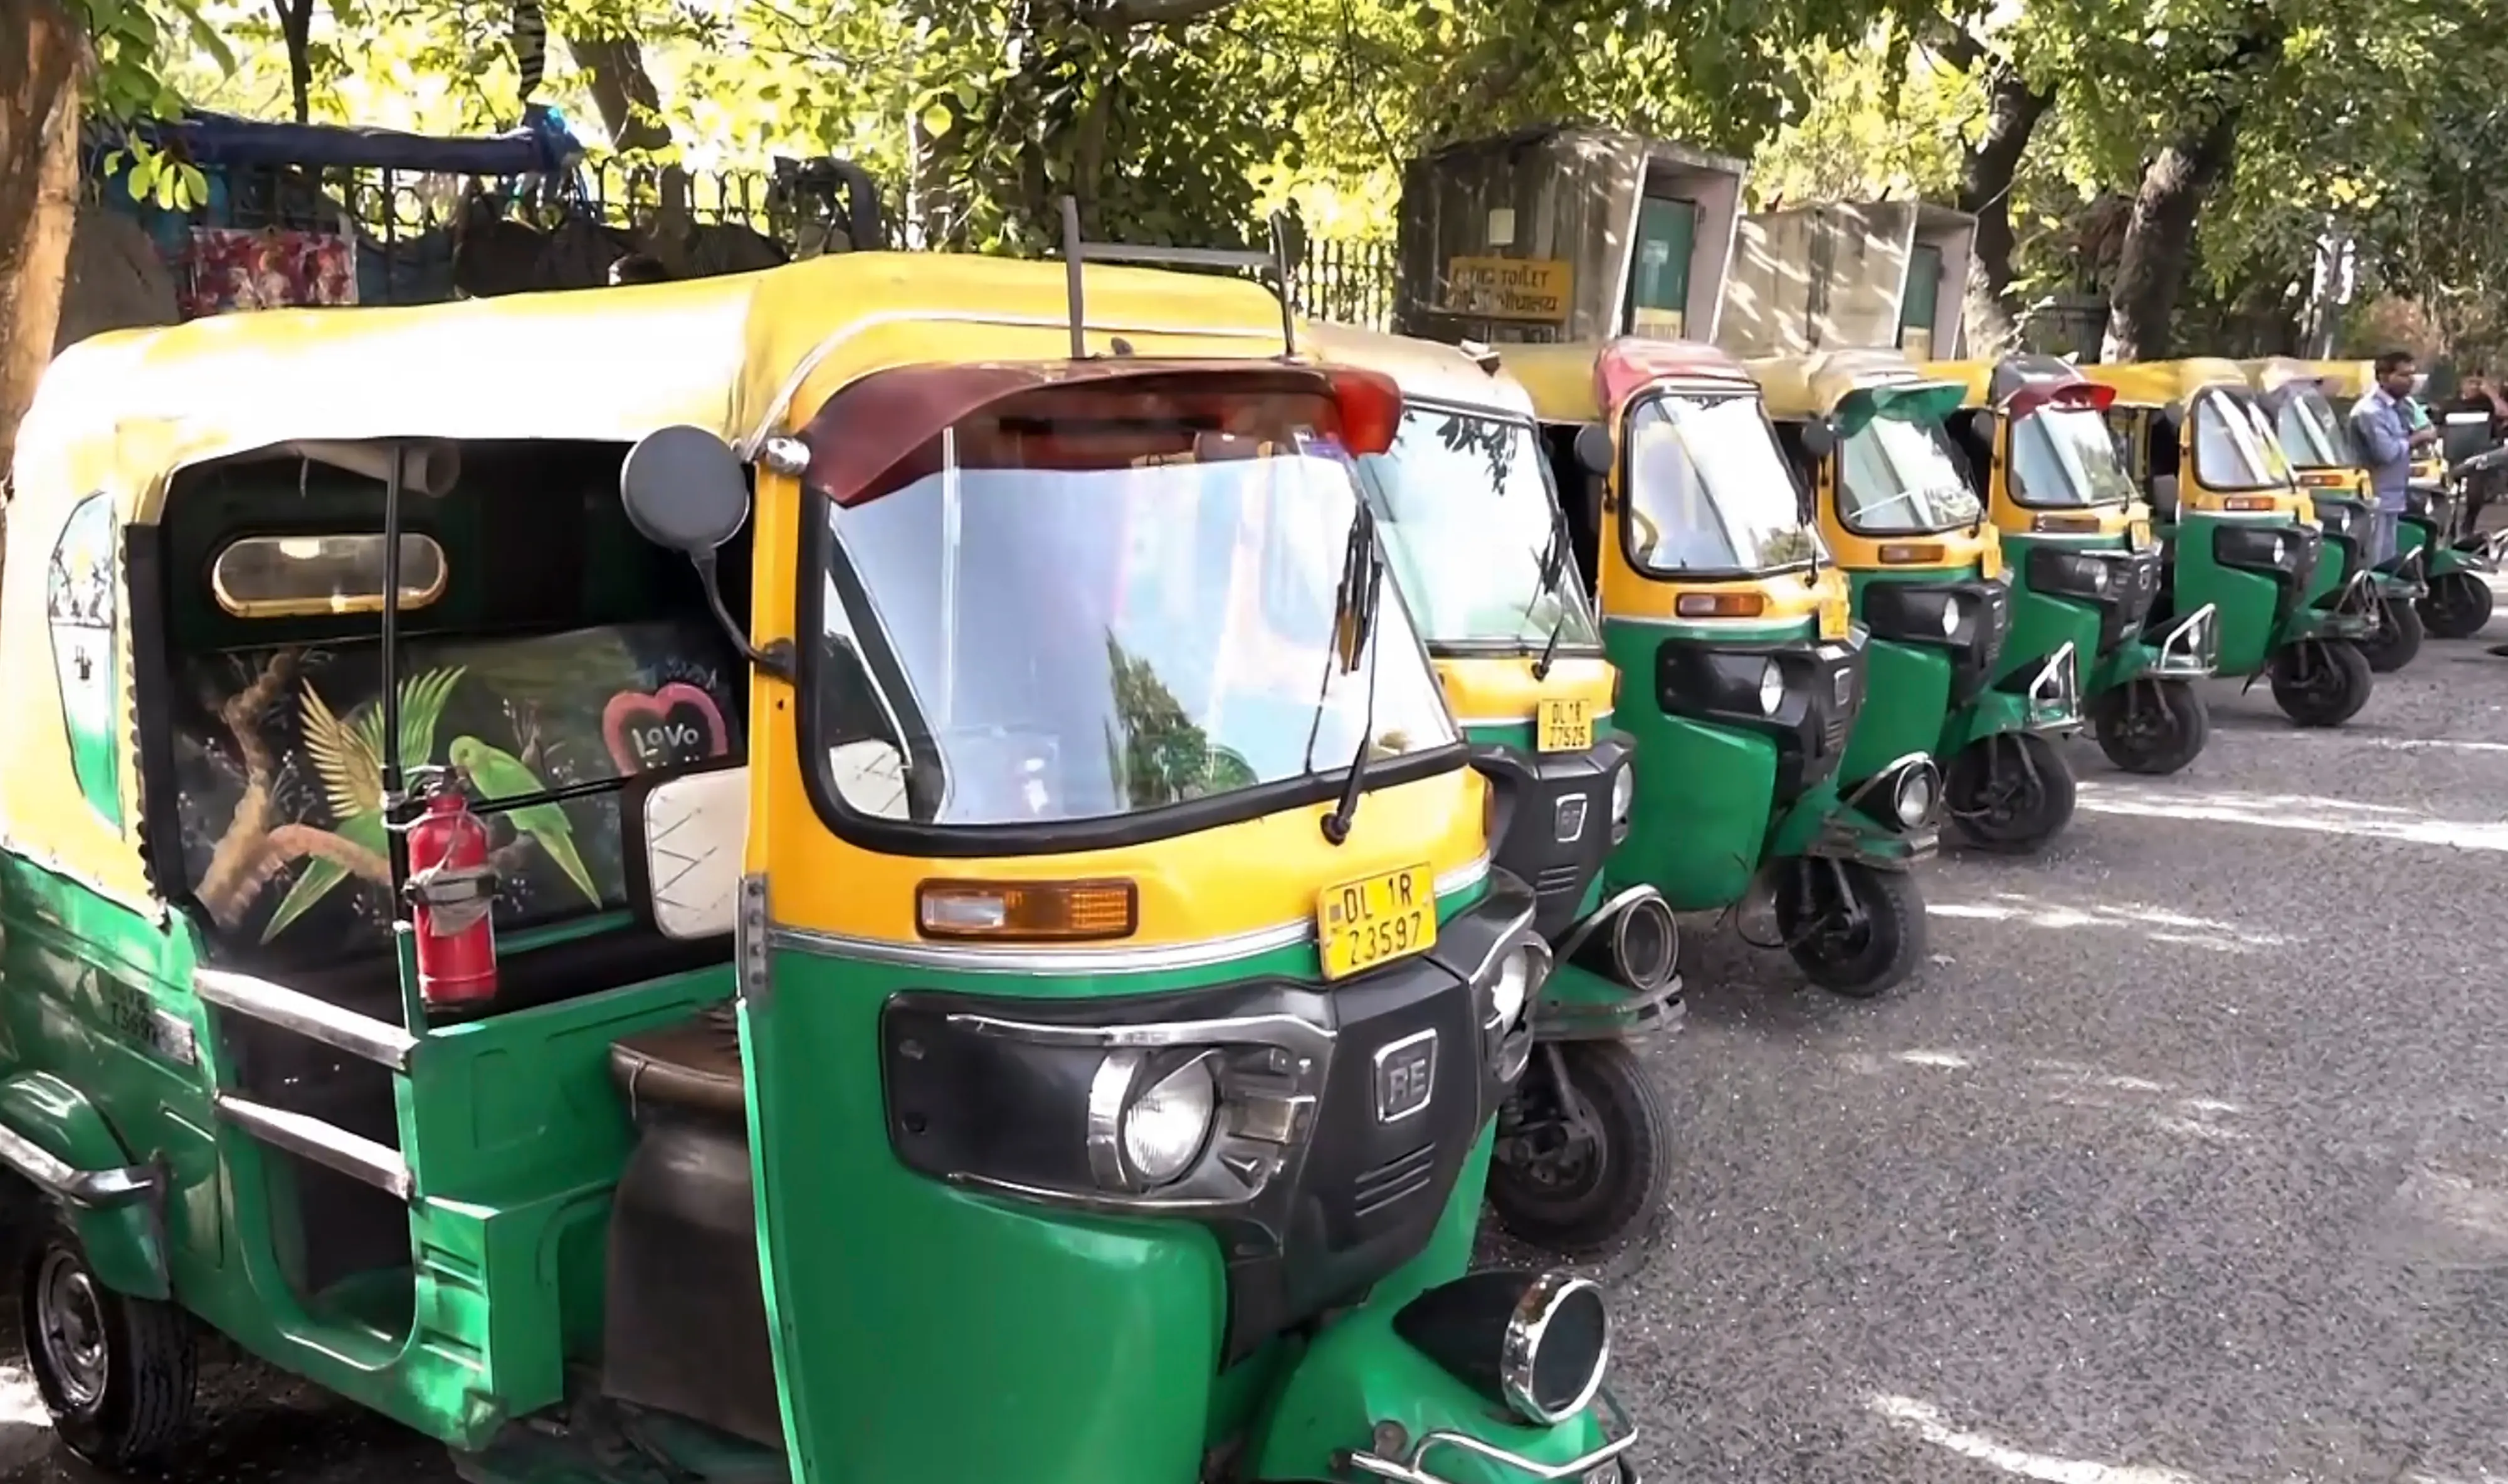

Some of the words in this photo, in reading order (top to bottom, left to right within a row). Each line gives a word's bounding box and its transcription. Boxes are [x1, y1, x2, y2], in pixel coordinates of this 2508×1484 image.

[1344, 885, 1374, 924] DL
[1388, 873, 1413, 907] 1R
[1389, 1058, 1426, 1105] RE
